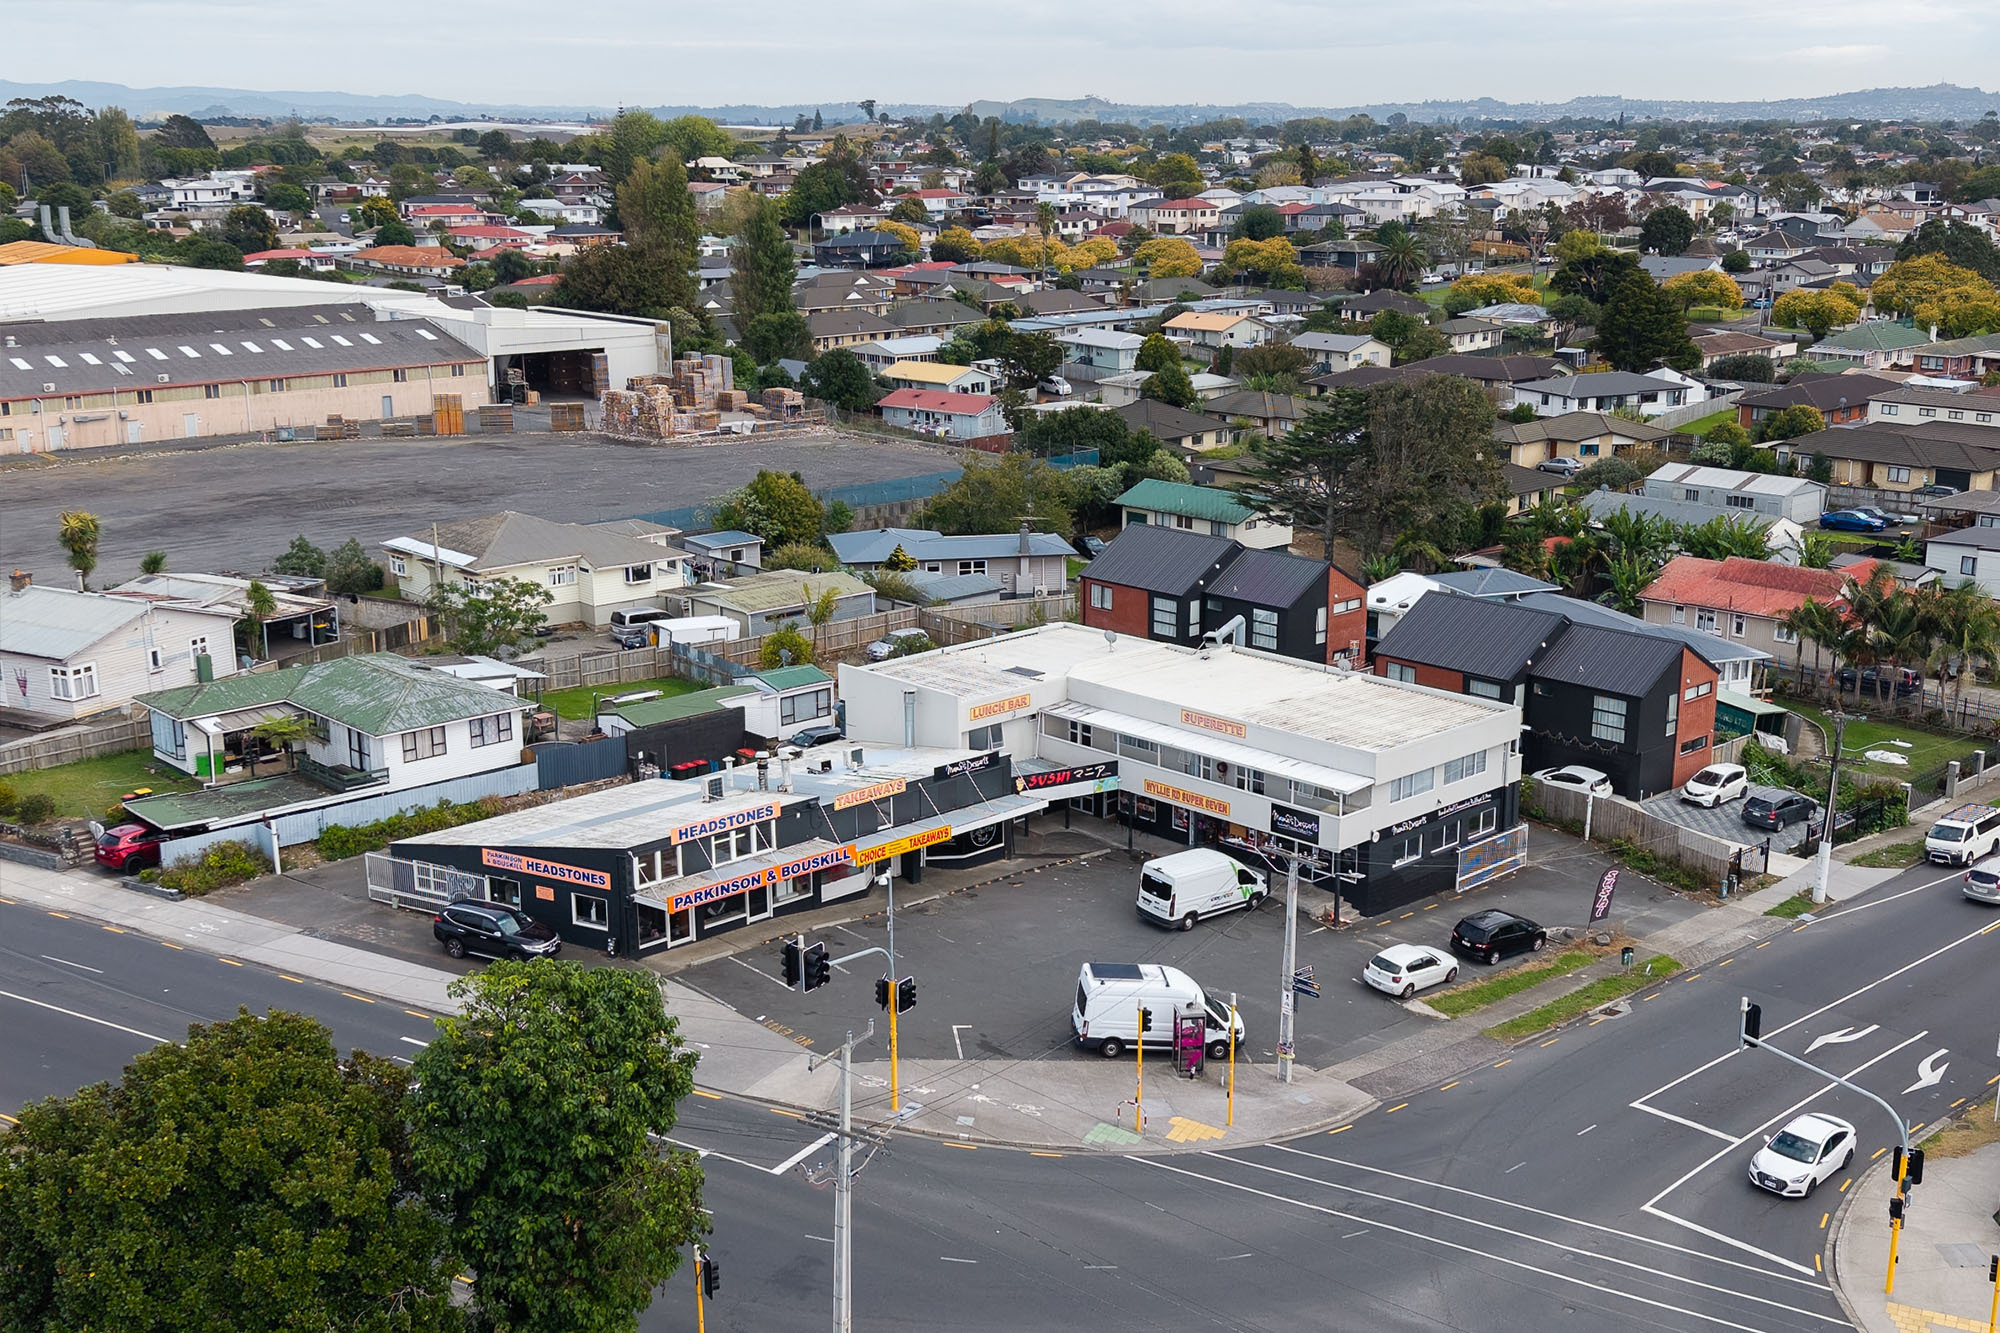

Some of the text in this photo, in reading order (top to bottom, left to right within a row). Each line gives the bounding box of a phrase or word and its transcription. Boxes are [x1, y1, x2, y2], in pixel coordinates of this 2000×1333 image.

[972, 696, 1028, 720] LUNCH BAR
[1183, 711, 1244, 737] SUPERETTE
[1028, 771, 1071, 787] SUSHI
[1073, 765, 1106, 779] マニア
[836, 779, 903, 807] TAKEAWAYS
[1181, 790, 1204, 808] SUPER
[1205, 797, 1228, 815] SEVEN
[678, 805, 774, 841] HEADSTONES
[859, 846, 886, 864] CHOICE
[908, 828, 949, 849] TAKEAWAYS
[526, 861, 606, 886] HEADSTONES
[674, 849, 851, 909] PARKINSON & BOUSKILL
